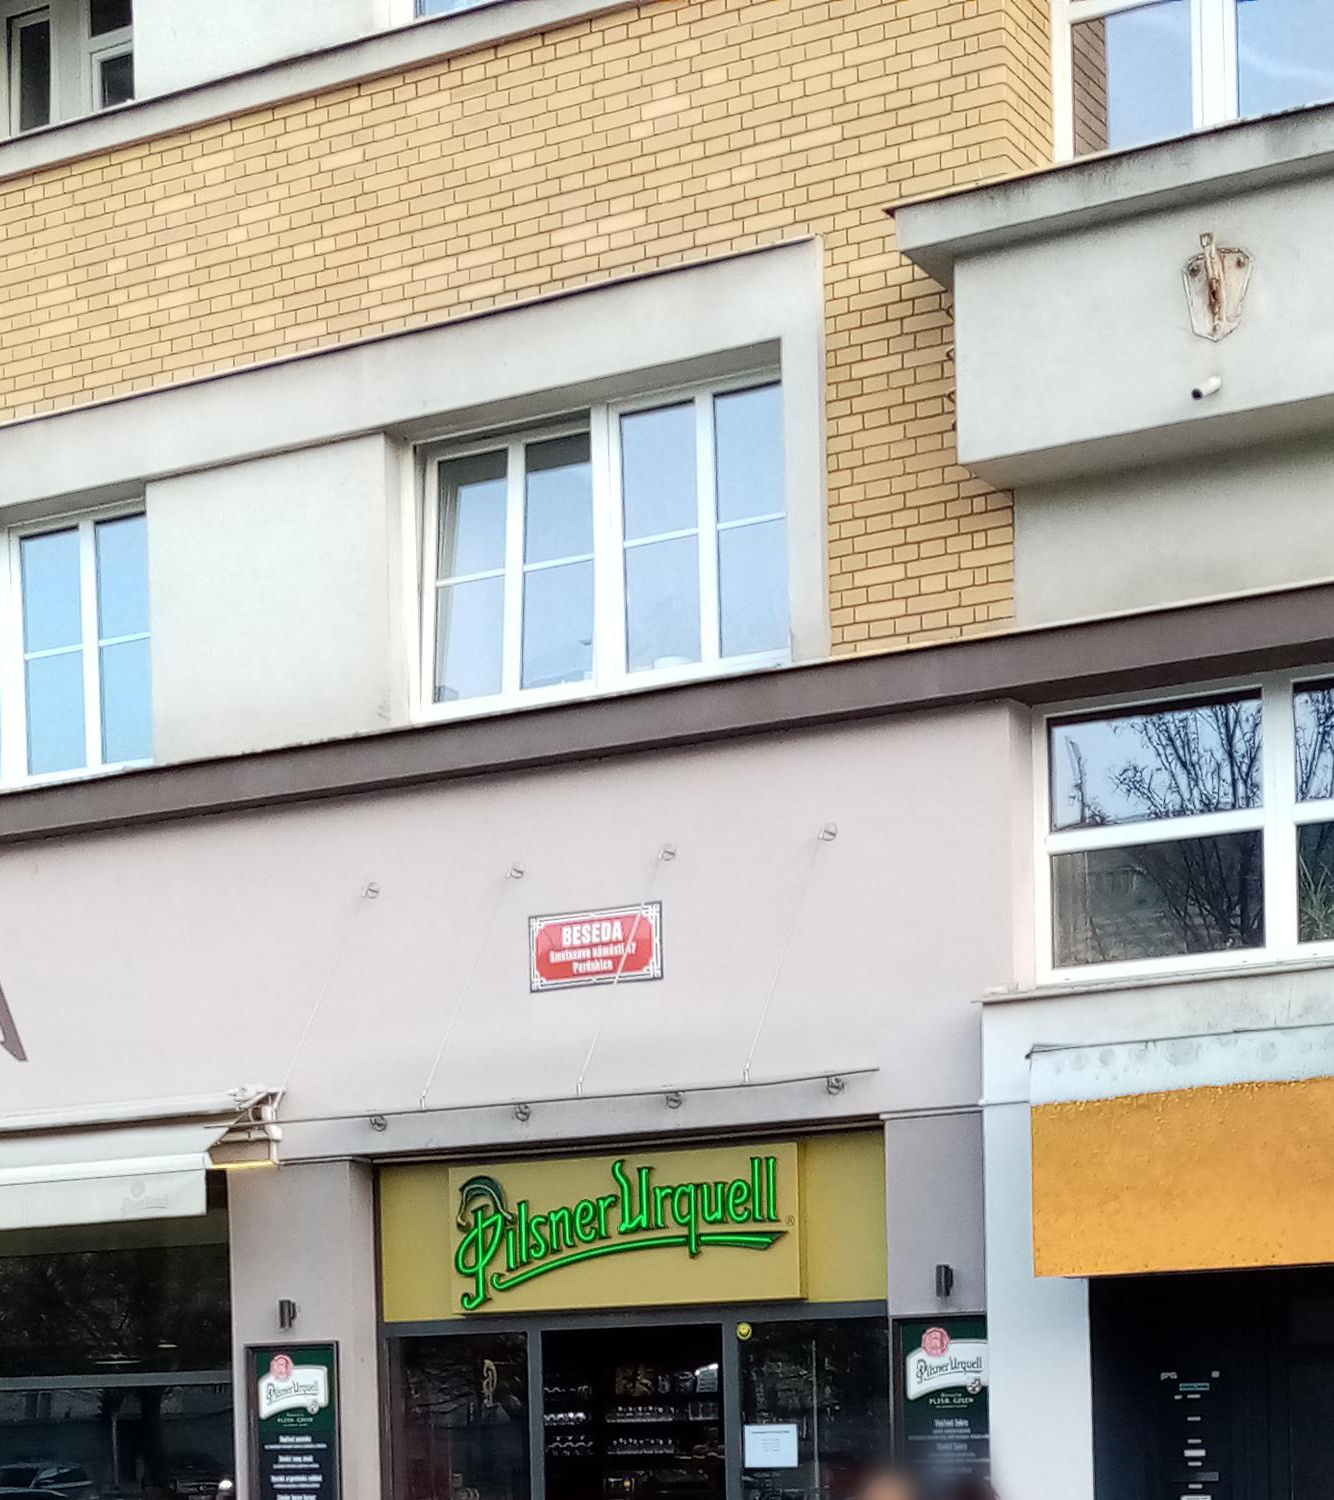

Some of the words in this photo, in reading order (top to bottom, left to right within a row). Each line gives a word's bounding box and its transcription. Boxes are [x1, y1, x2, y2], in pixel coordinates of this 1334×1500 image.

[562, 920, 623, 946] BESEDA
[572, 959, 613, 974] Pardubice
[455, 1175, 618, 1310] Pilsner
[611, 1156, 778, 1258] Urquell
